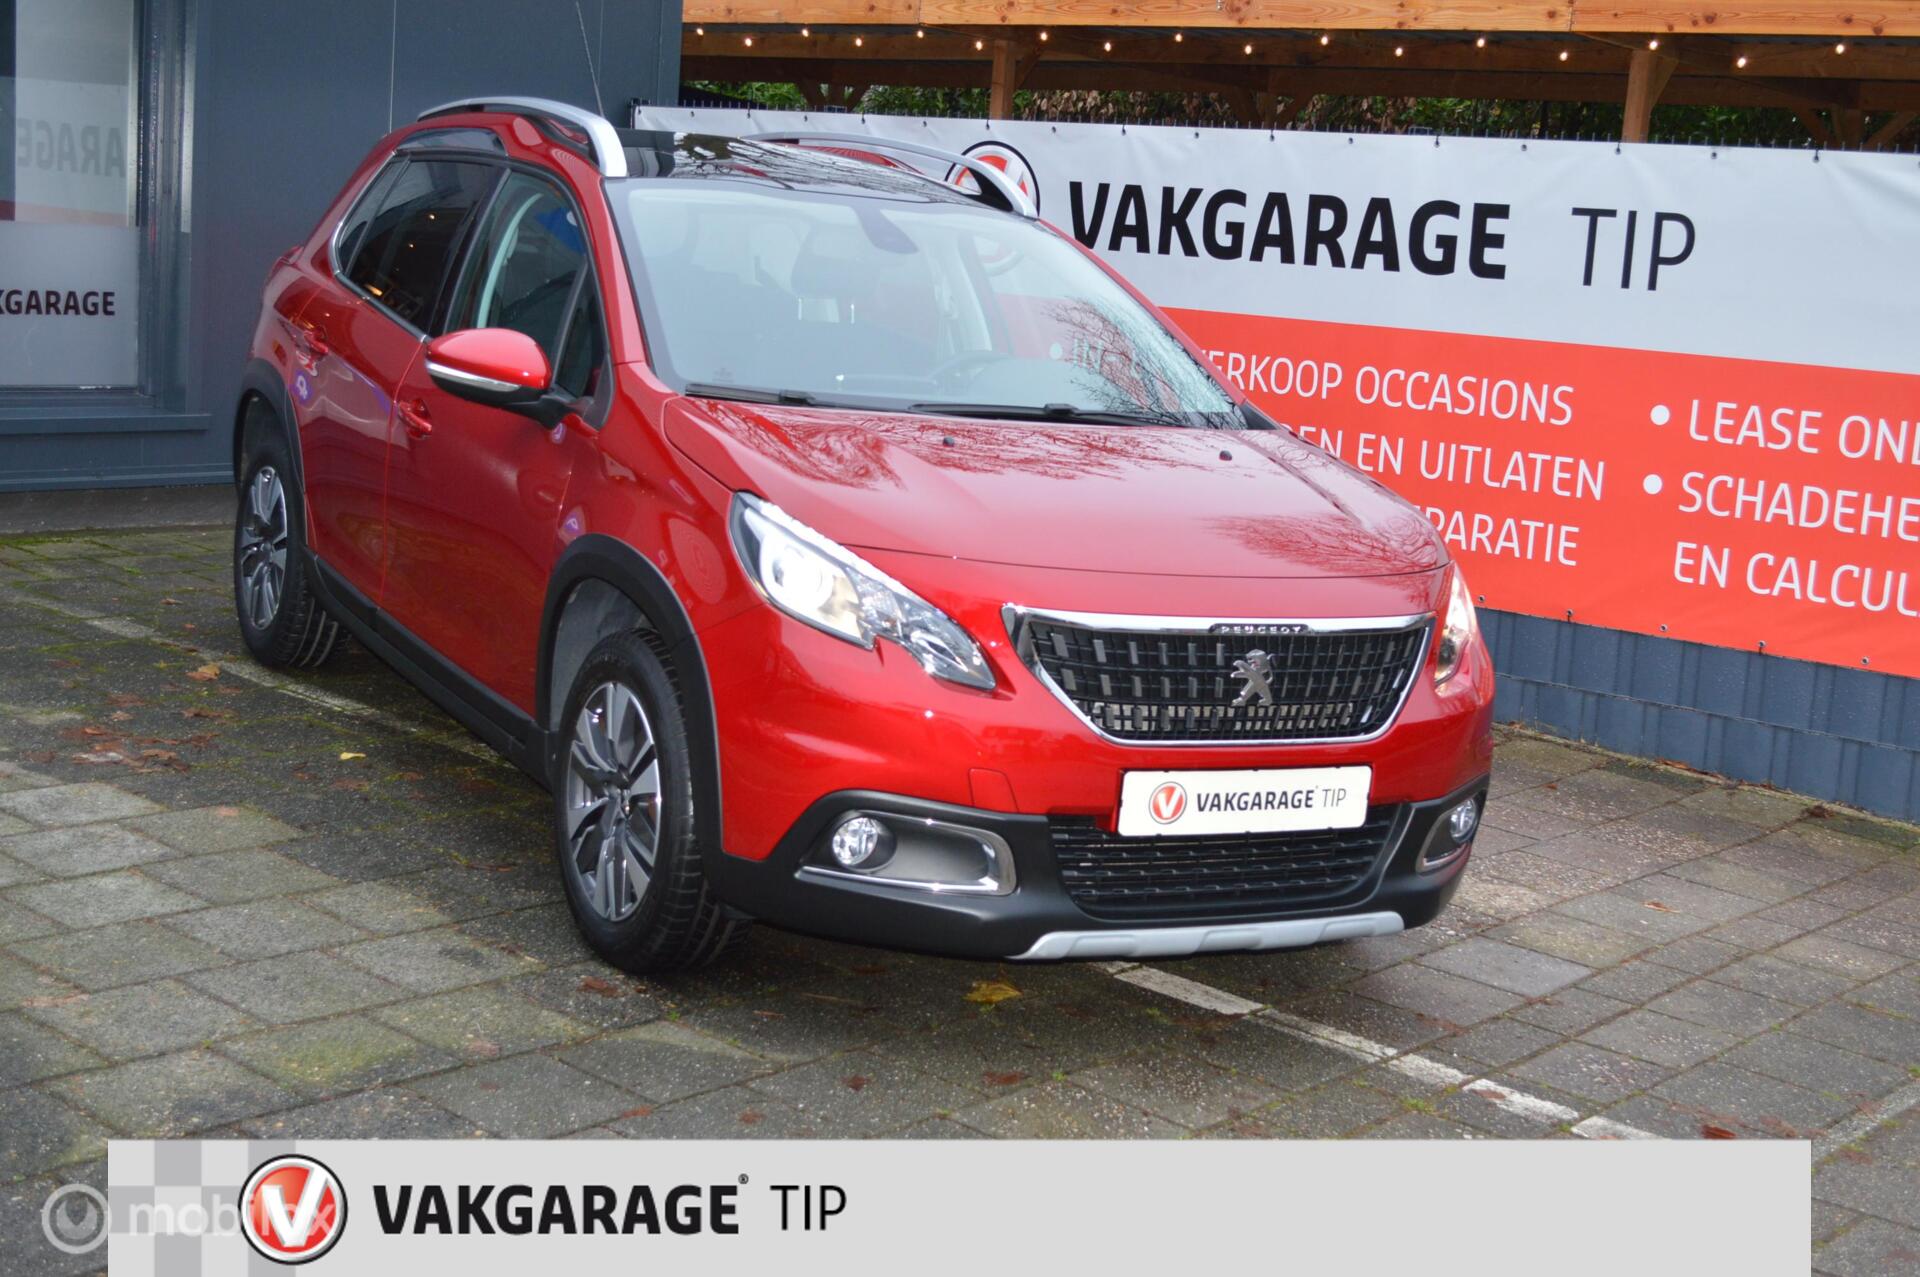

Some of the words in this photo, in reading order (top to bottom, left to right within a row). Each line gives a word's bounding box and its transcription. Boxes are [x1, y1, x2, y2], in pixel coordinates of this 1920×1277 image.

[1069, 181, 1510, 280] VAKGARAGE
[1571, 207, 1696, 291] TIP
[1201, 349, 1344, 400] RKOOP
[1355, 366, 1574, 425] OCCASIONS
[1689, 399, 1823, 454] LEASE
[1357, 432, 1404, 475] EN
[1419, 440, 1605, 501] UITLATEN
[1413, 505, 1580, 566] PARATIE
[1678, 471, 1920, 543] SCHADEHE
[1674, 541, 1730, 588] EN
[1221, 625, 1301, 635] PEUGEOT
[1322, 787, 1347, 808] TIP
